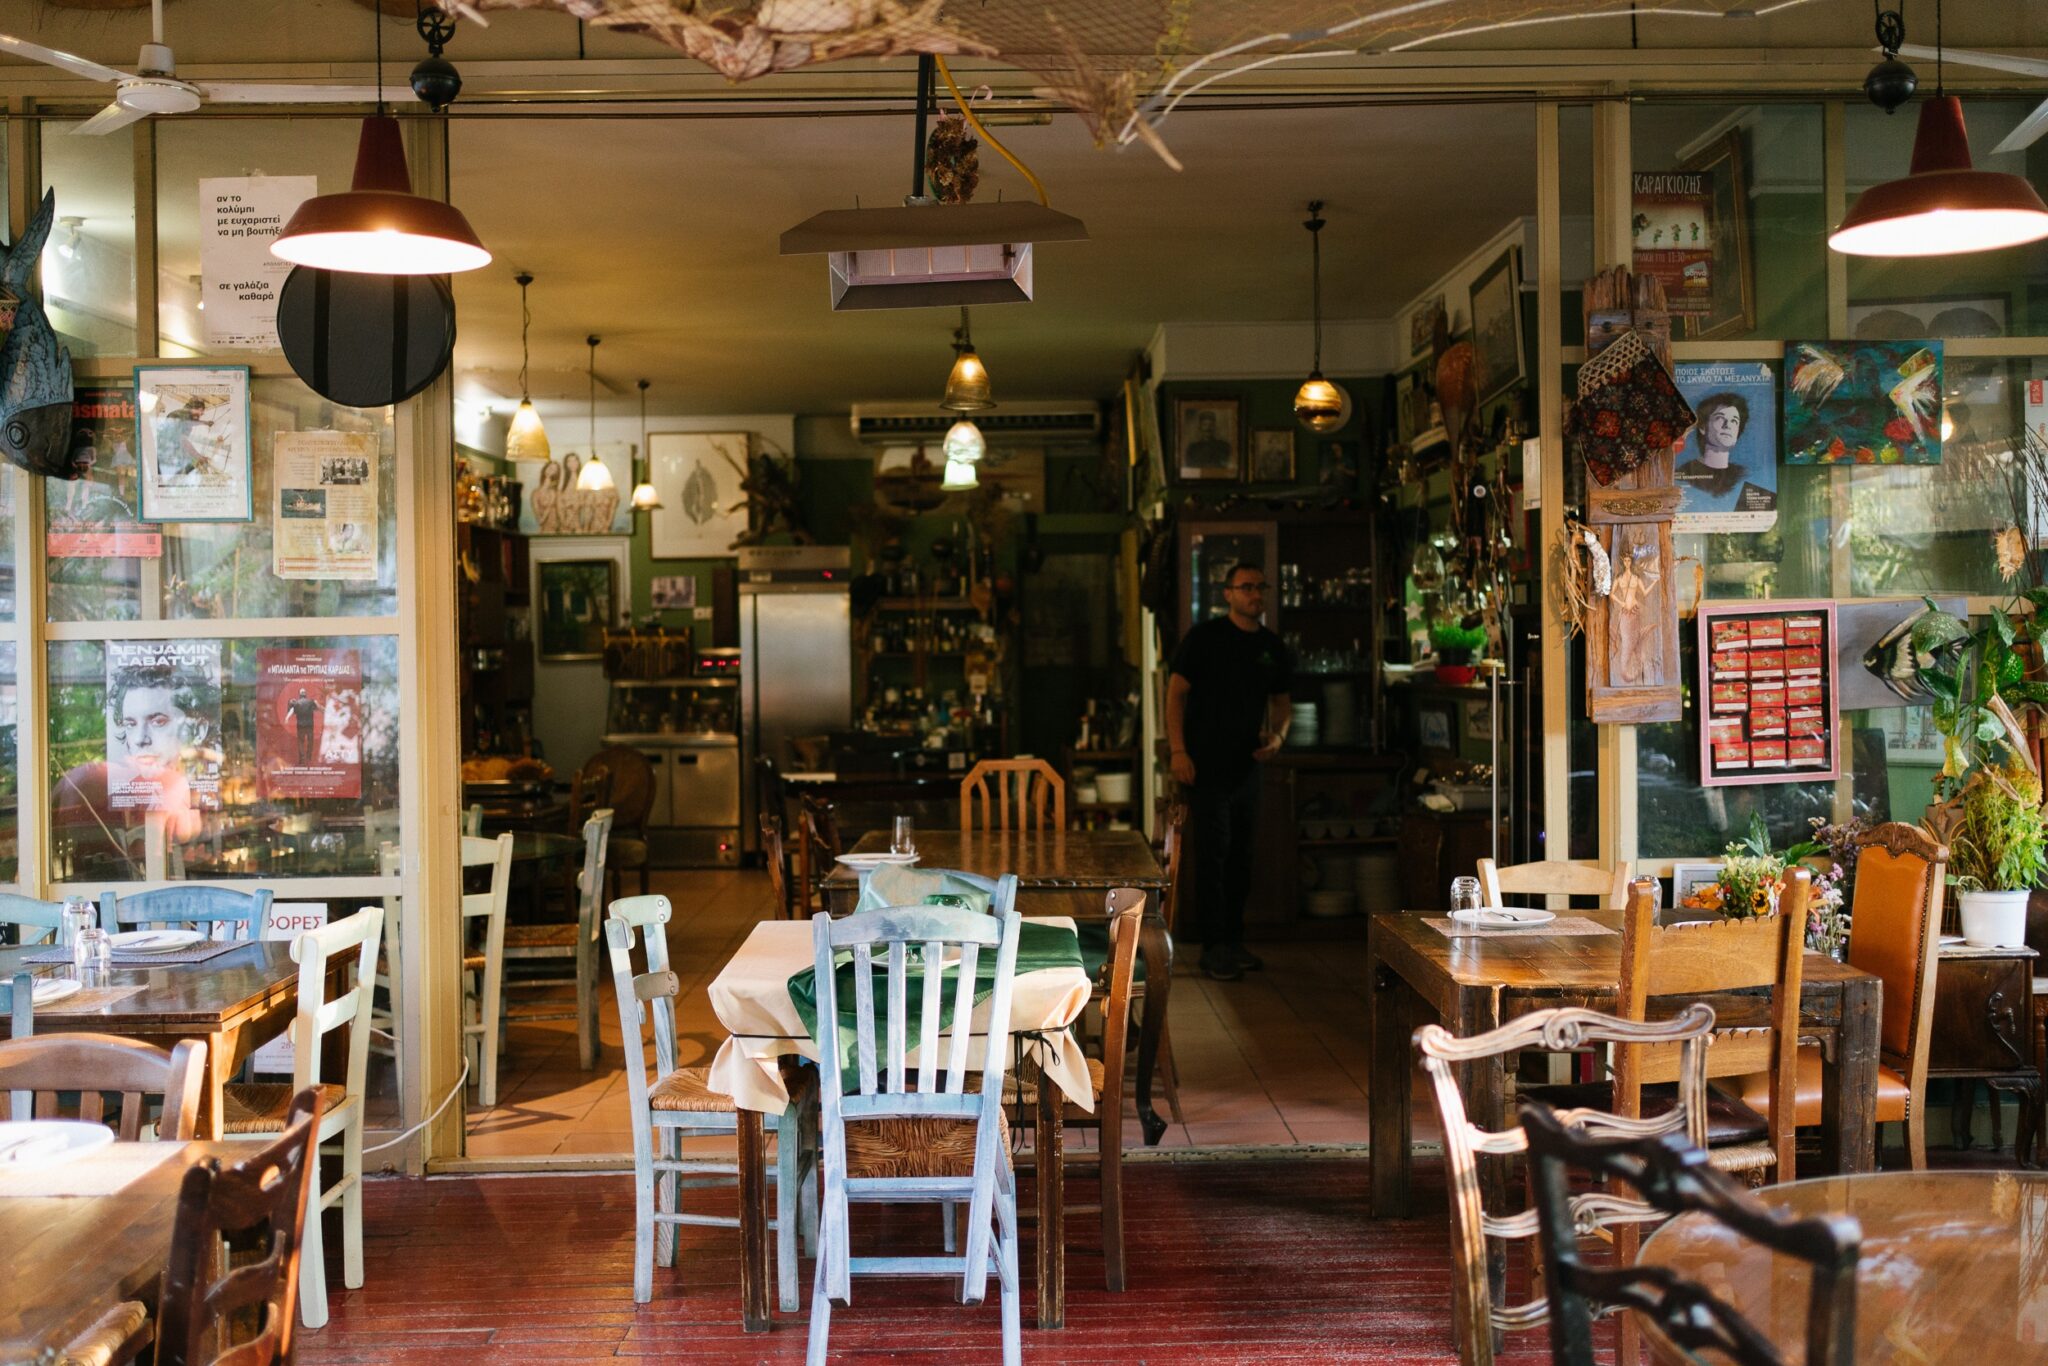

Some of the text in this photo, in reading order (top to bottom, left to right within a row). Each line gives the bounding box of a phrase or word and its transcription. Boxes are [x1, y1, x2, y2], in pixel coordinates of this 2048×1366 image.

[1634, 173, 1703, 194] ΚΑΡΑΓΚΙΟΖΗΣ
[216, 194, 242, 203] αν το
[216, 204, 255, 214] κολύμπι
[217, 214, 281, 227] με ευχαριστεί
[231, 229, 244, 237] μη
[218, 281, 270, 291] σε γαλάζια
[238, 291, 275, 302] καθαρά
[1714, 375, 1723, 383] ΤΑ
[109, 644, 218, 655] BENJAMIN
[117, 655, 209, 667] LABATUT
[271, 664, 300, 674] ΜΠΑΛΑΝΤΑ
